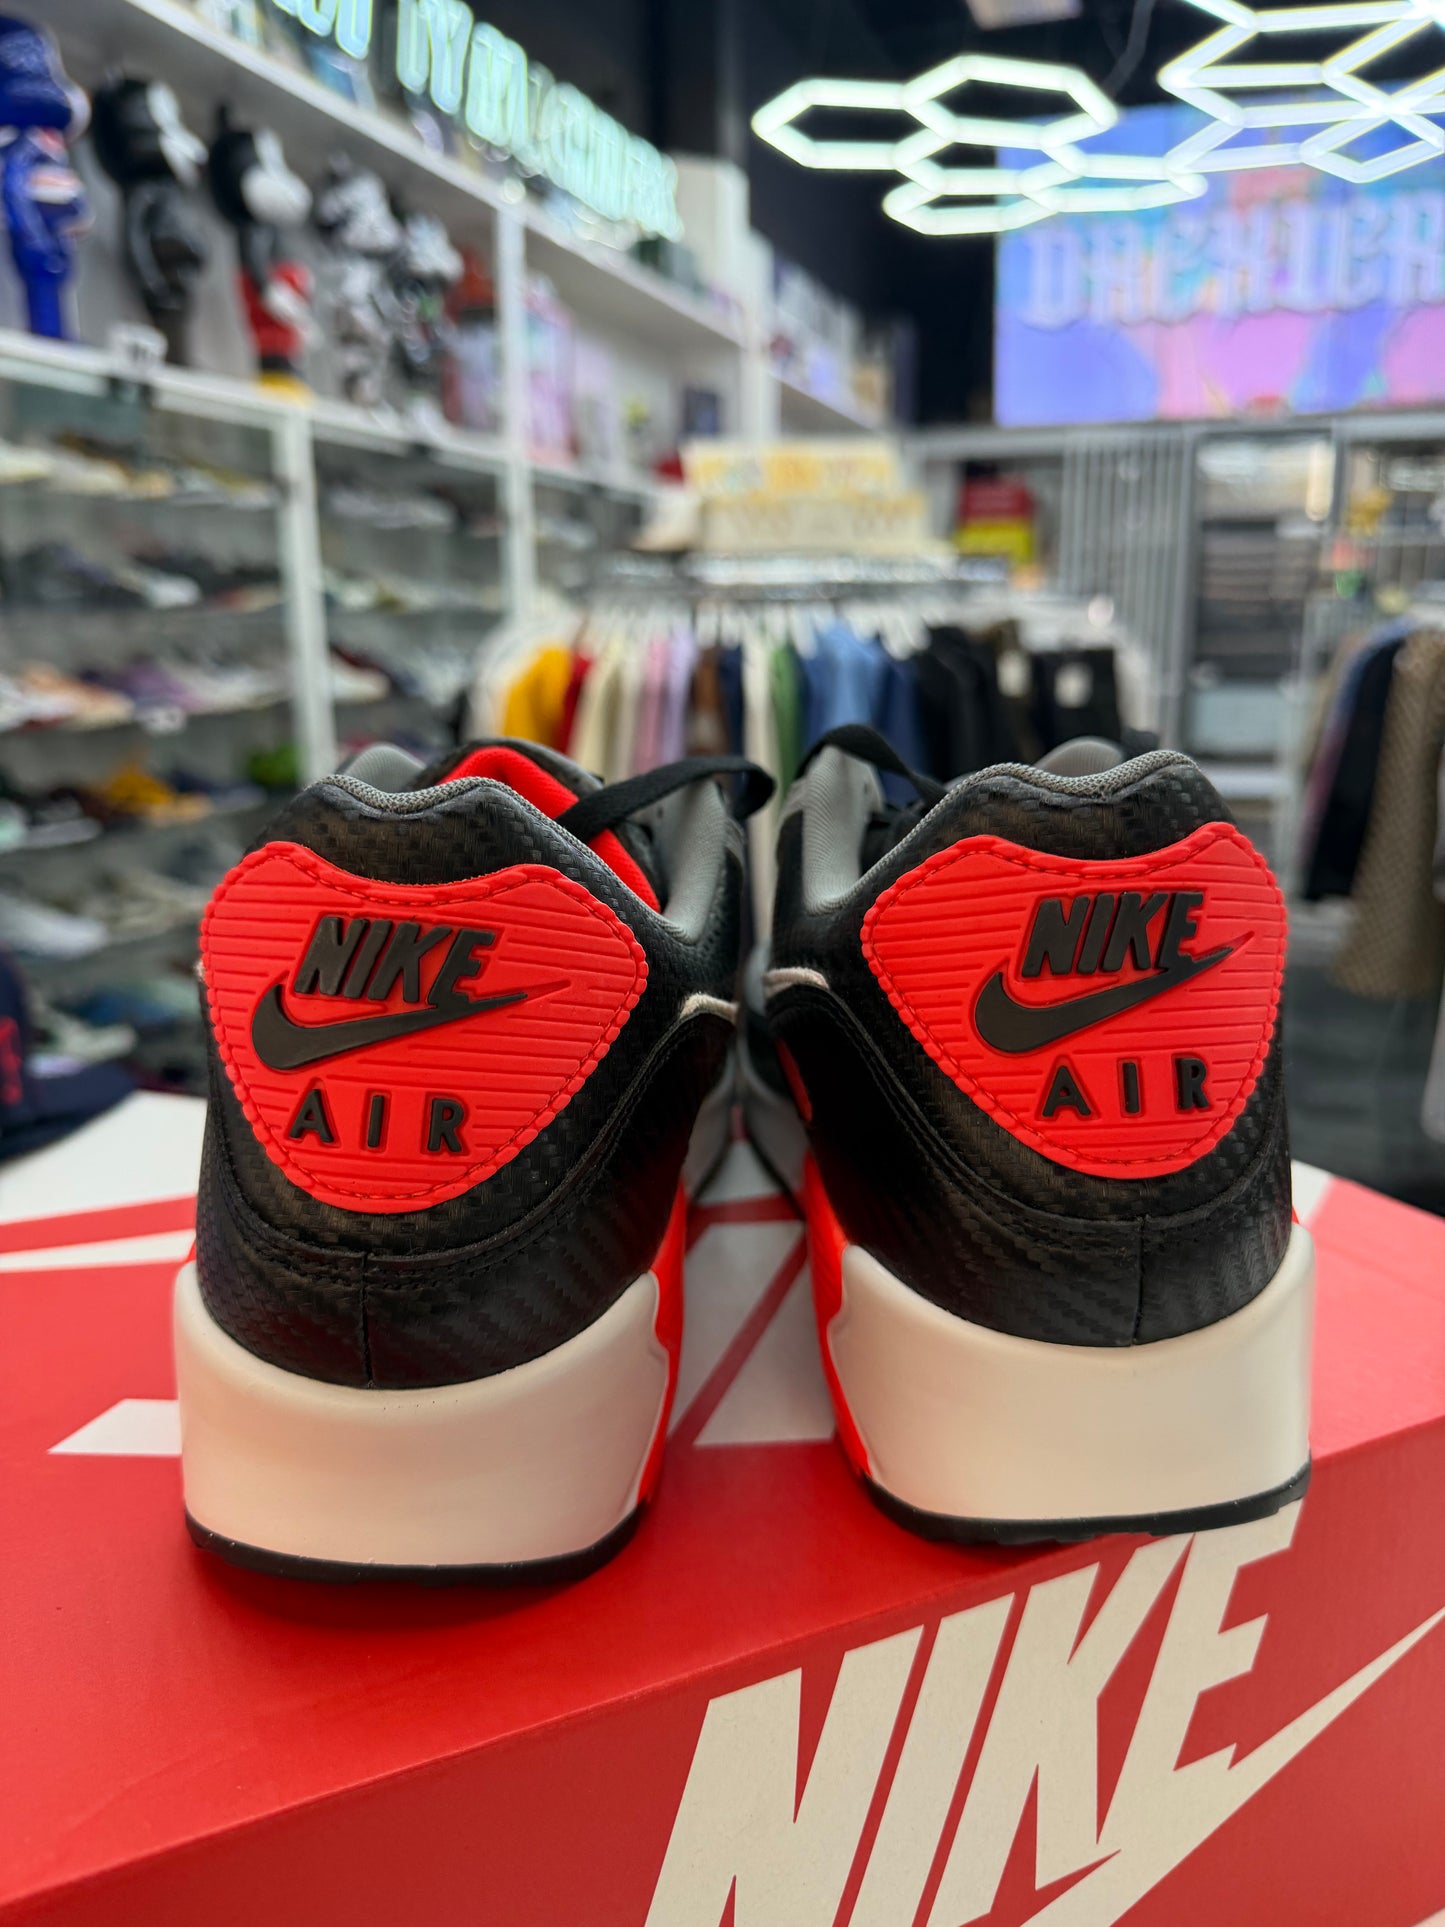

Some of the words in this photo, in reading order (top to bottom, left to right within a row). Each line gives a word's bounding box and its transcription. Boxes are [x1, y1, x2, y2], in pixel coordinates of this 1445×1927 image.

[295, 918, 496, 1007] NIKE
[1022, 892, 1204, 977] NIKE
[288, 1089, 466, 1151] AIR
[1043, 1058, 1209, 1116] AIR
[645, 1500, 1304, 1927] NIKE
